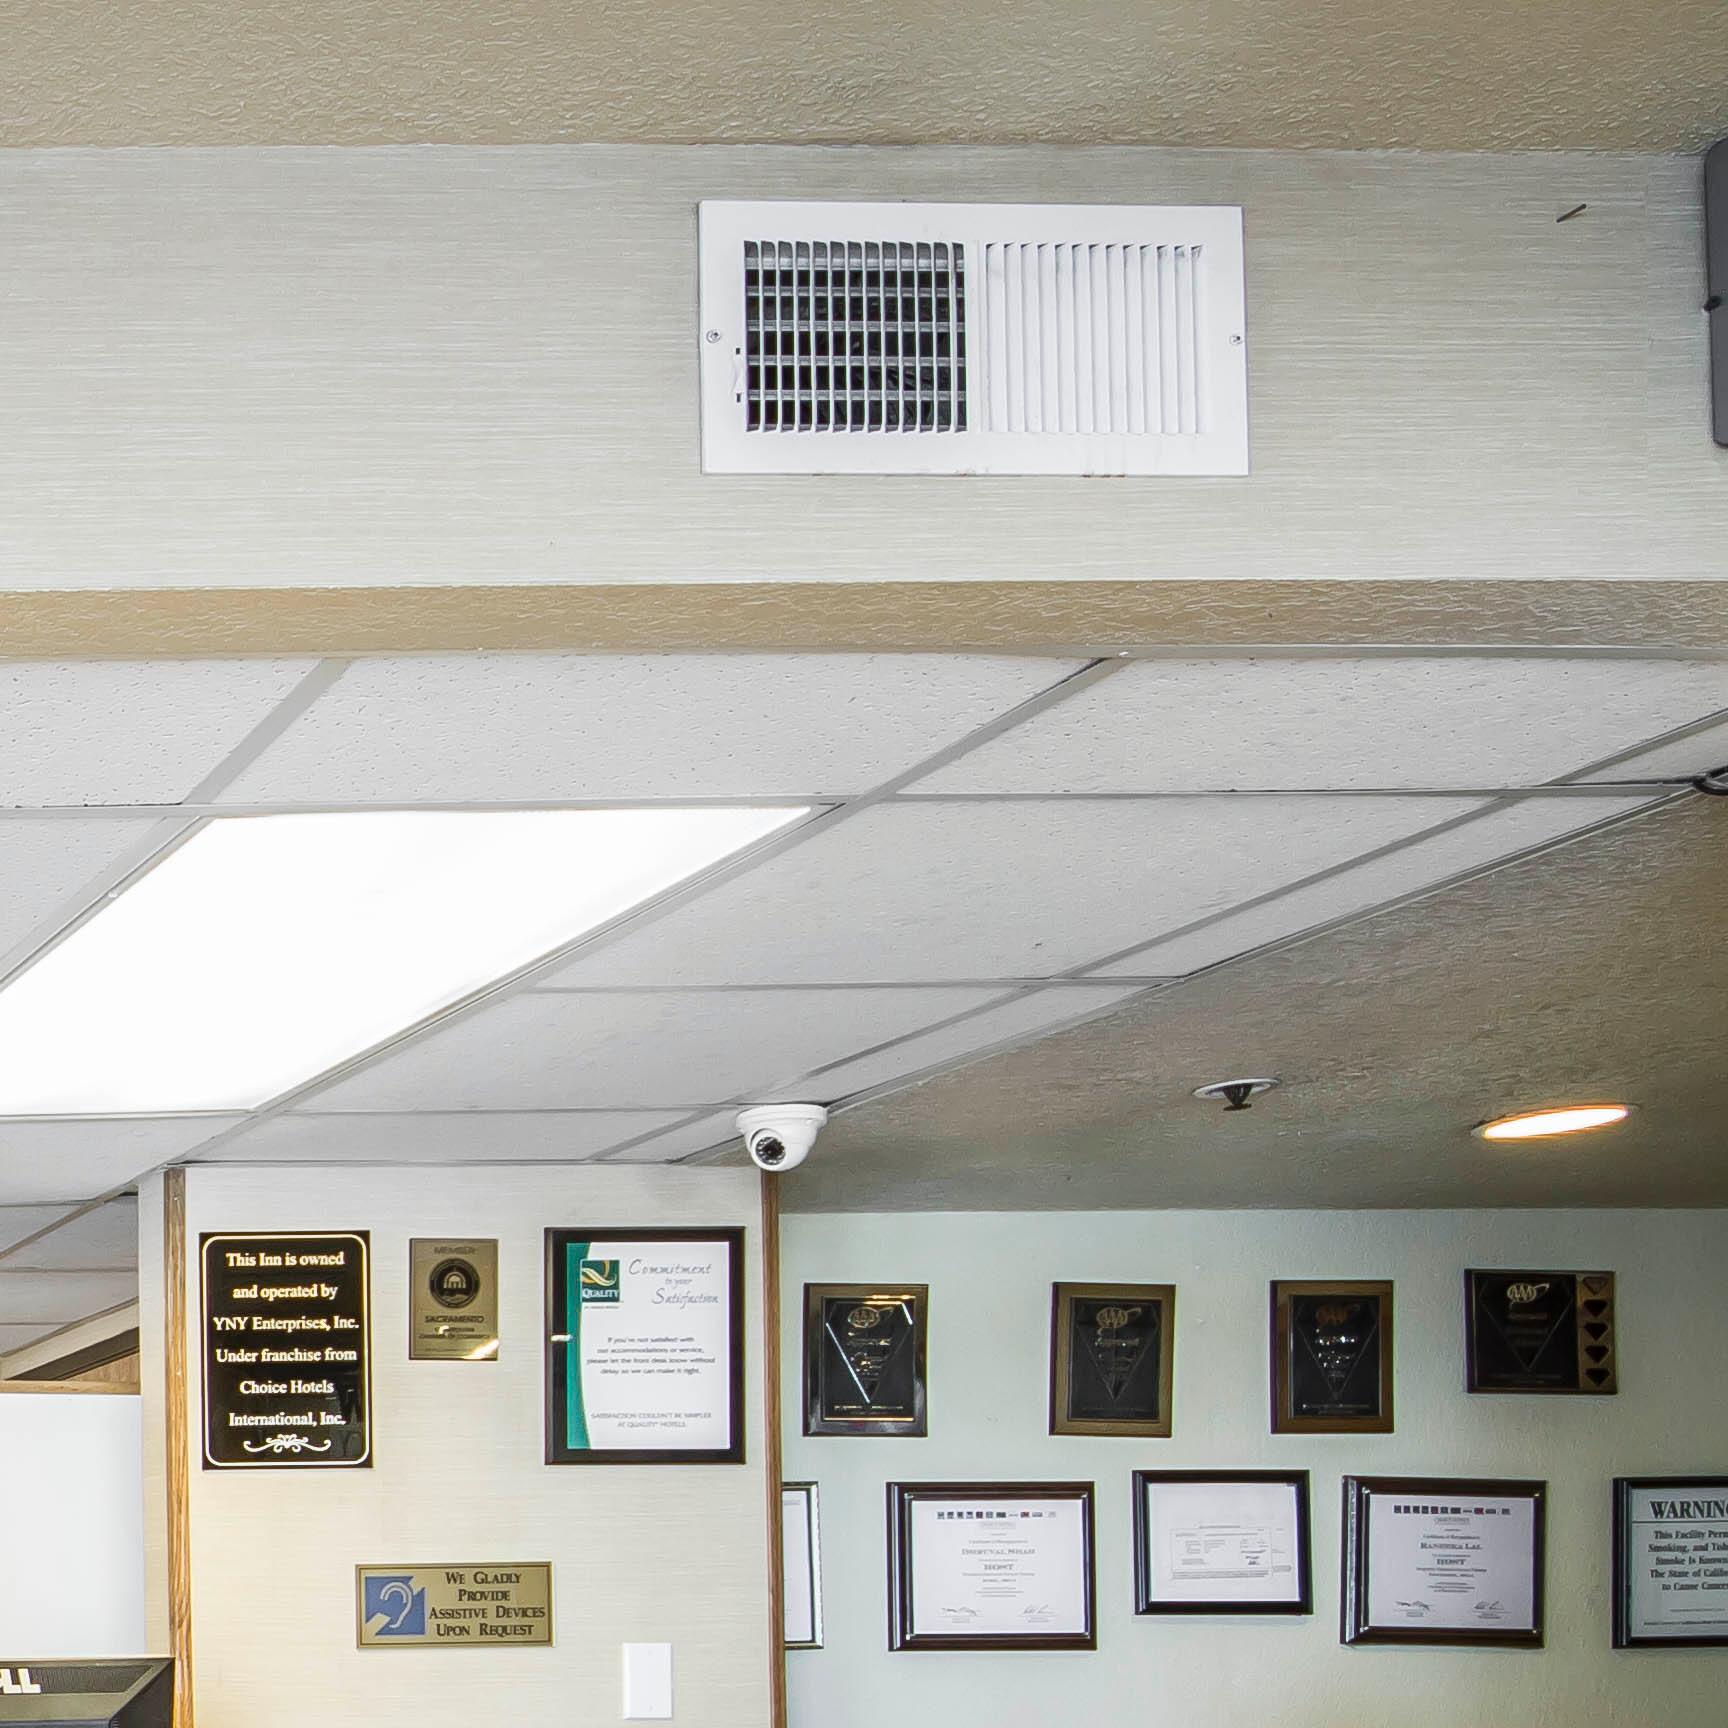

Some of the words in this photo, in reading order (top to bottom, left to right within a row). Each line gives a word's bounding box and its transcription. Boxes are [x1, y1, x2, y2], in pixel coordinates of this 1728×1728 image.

[225, 1252, 256, 1266] This
[259, 1252, 283, 1266] Inn
[285, 1252, 297, 1266] is
[299, 1251, 345, 1266] owned
[629, 1258, 712, 1275] Commitment
[233, 1285, 258, 1298] and
[260, 1284, 318, 1301] operated
[321, 1284, 338, 1300] by
[583, 1289, 619, 1298] QUALITY
[652, 1287, 719, 1309] Satisfaction
[213, 1316, 249, 1331] YNY
[252, 1316, 331, 1333] Enterprises,
[333, 1316, 359, 1329] Inc.
[216, 1348, 258, 1363] Under
[261, 1348, 322, 1362] franchise
[324, 1347, 357, 1361] from
[239, 1380, 287, 1394] Choice
[290, 1380, 335, 1394] Hotels
[228, 1412, 317, 1427] International,
[319, 1411, 347, 1426] Inc.
[1649, 1500, 1728, 1519] WARNIN
[1654, 1530, 1673, 1539] This
[1675, 1529, 1706, 1541] Facility
[1648, 1543, 1690, 1555] Smoking,
[1693, 1543, 1709, 1551] and
[445, 1572, 465, 1584] WE
[473, 1571, 522, 1584] GLADLY
[1650, 1569, 1665, 1578] The
[1692, 1569, 1701, 1577] of
[458, 1588, 511, 1601] PROVIDE
[429, 1607, 488, 1619] ASSISTIVE
[495, 1605, 545, 1618] DEVICES
[436, 1623, 470, 1636] UPON
[479, 1622, 535, 1637] REQUEST
